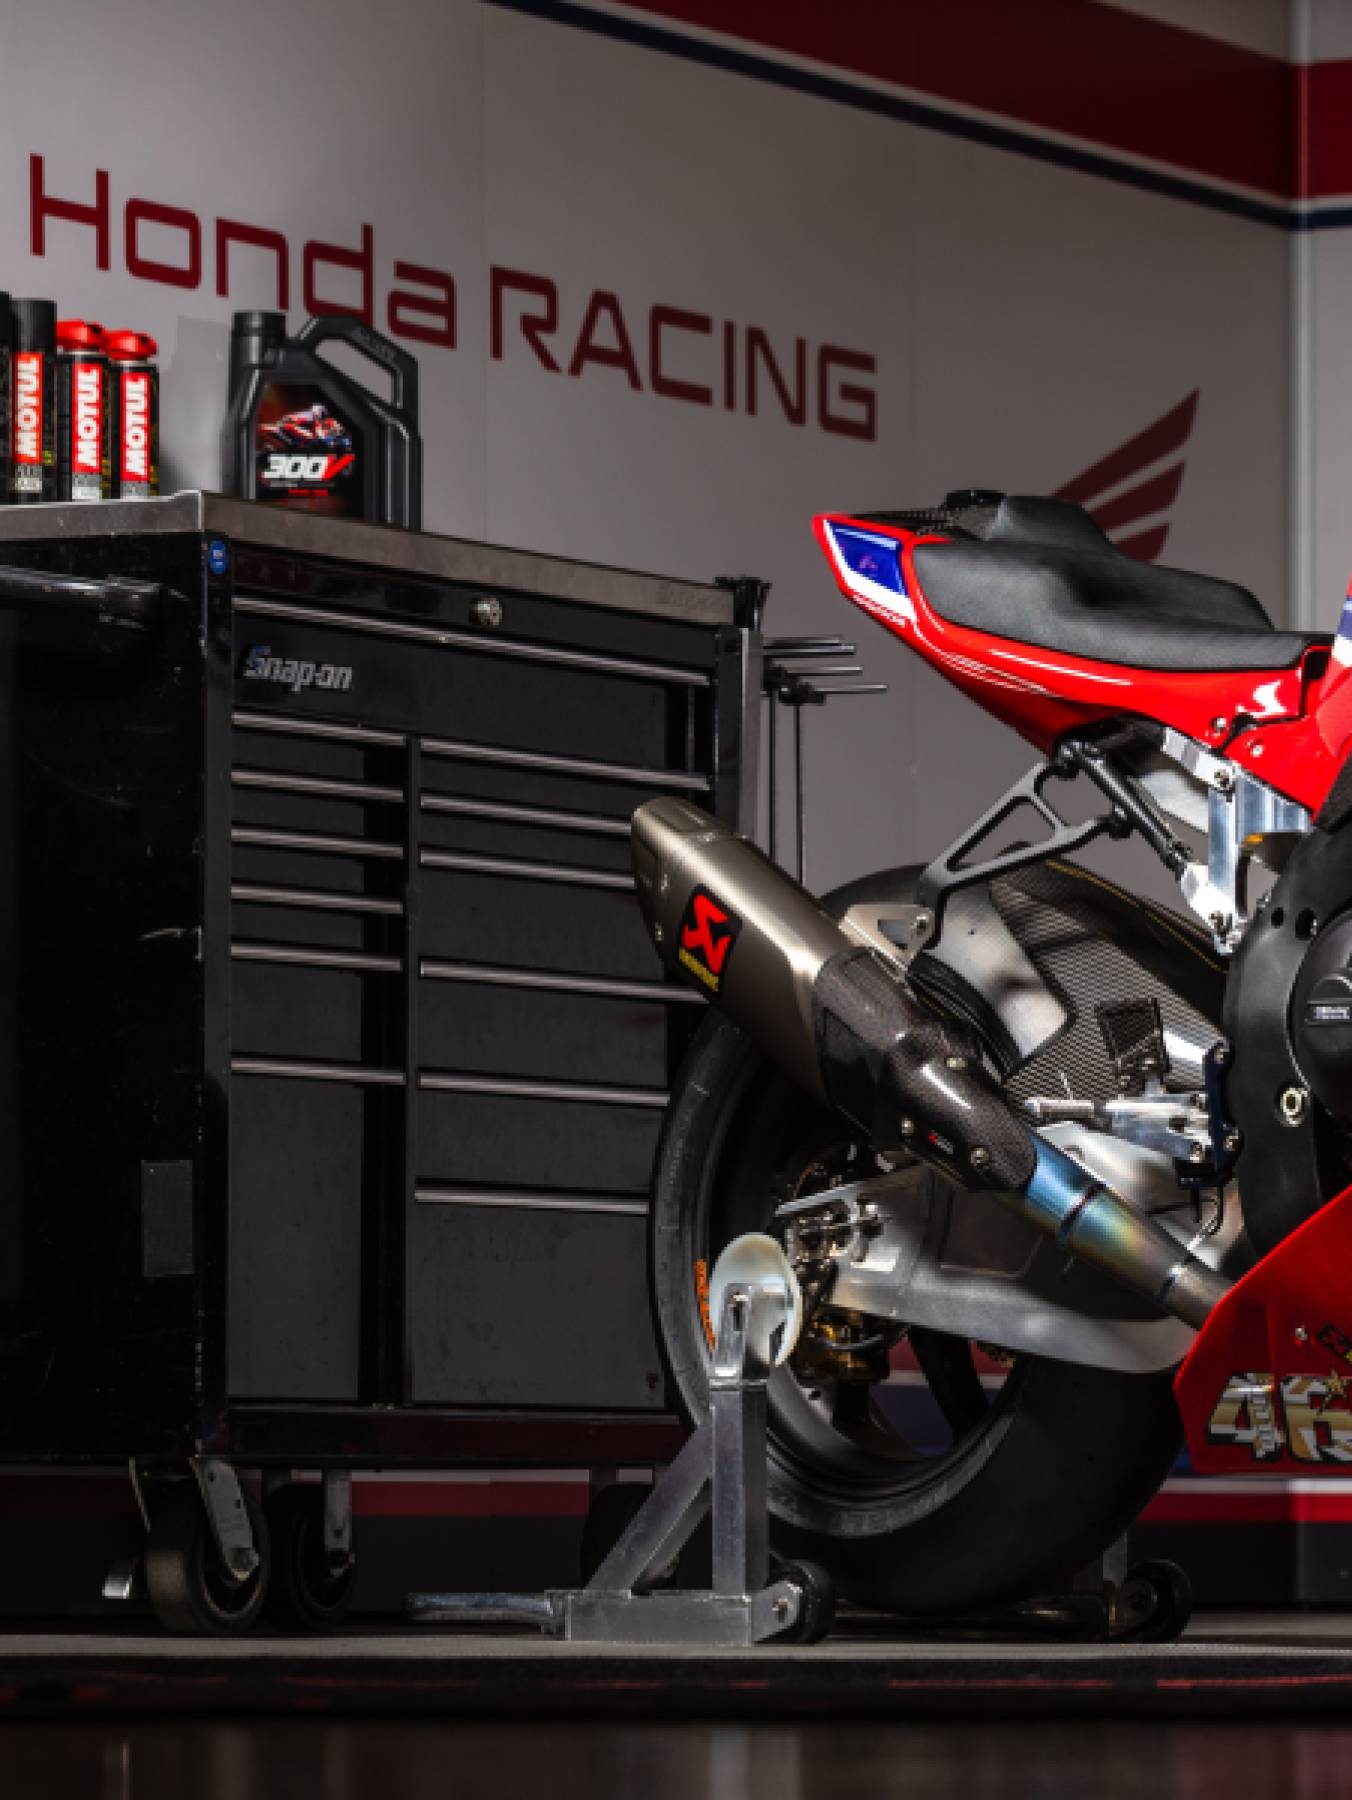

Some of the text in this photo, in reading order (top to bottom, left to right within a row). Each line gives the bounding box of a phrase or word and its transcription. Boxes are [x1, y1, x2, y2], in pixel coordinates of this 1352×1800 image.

[30, 153, 877, 443] Honda RACING
[17, 357, 39, 458] MOTUL
[77, 368, 99, 468] MOTUL
[125, 377, 147, 476] MOTUL
[262, 453, 356, 481] 300V
[244, 644, 353, 692] Snap-on
